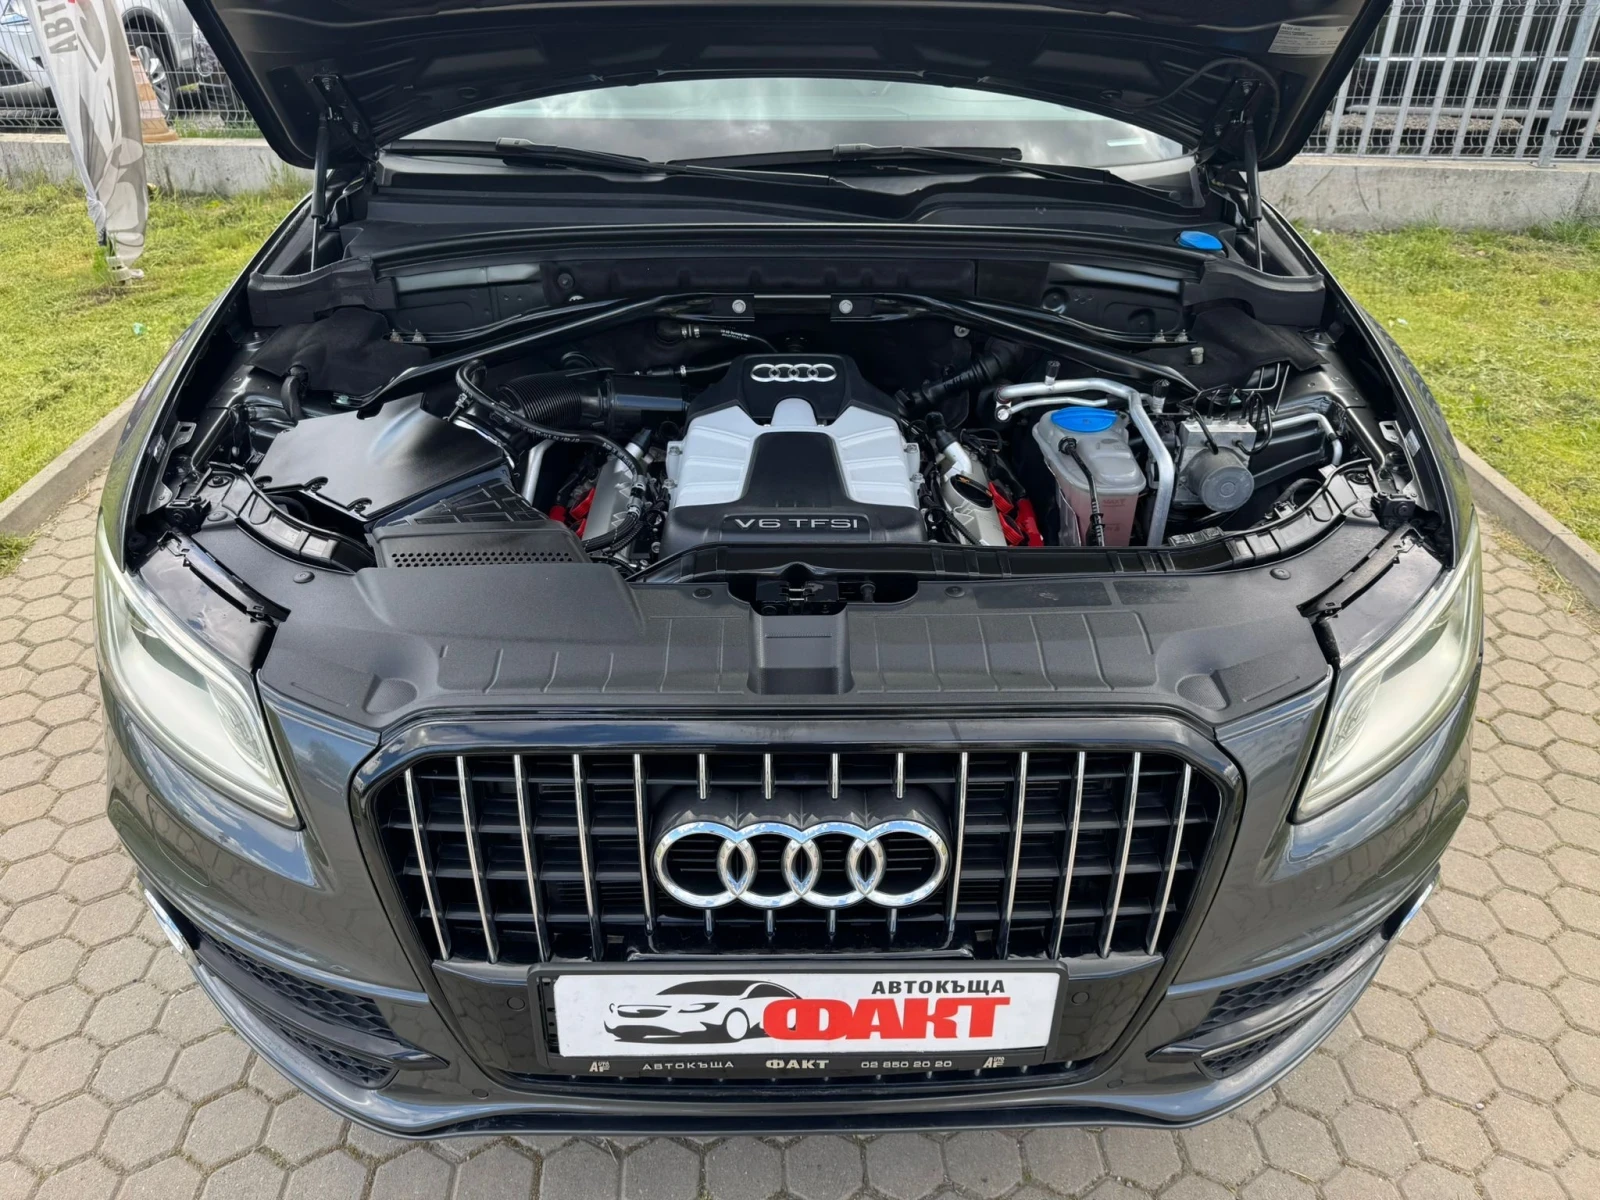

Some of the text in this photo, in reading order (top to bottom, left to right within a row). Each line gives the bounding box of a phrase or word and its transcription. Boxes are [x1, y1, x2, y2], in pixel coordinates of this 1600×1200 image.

[37, 0, 79, 54] АВТ
[735, 518, 858, 529] V6 TFSI
[871, 979, 1005, 996] АВТОКЪЩА
[762, 996, 1011, 1041] ФАКТ
[765, 1059, 830, 1069] ФАКТ
[861, 1060, 953, 1069] 02 850 20 20
